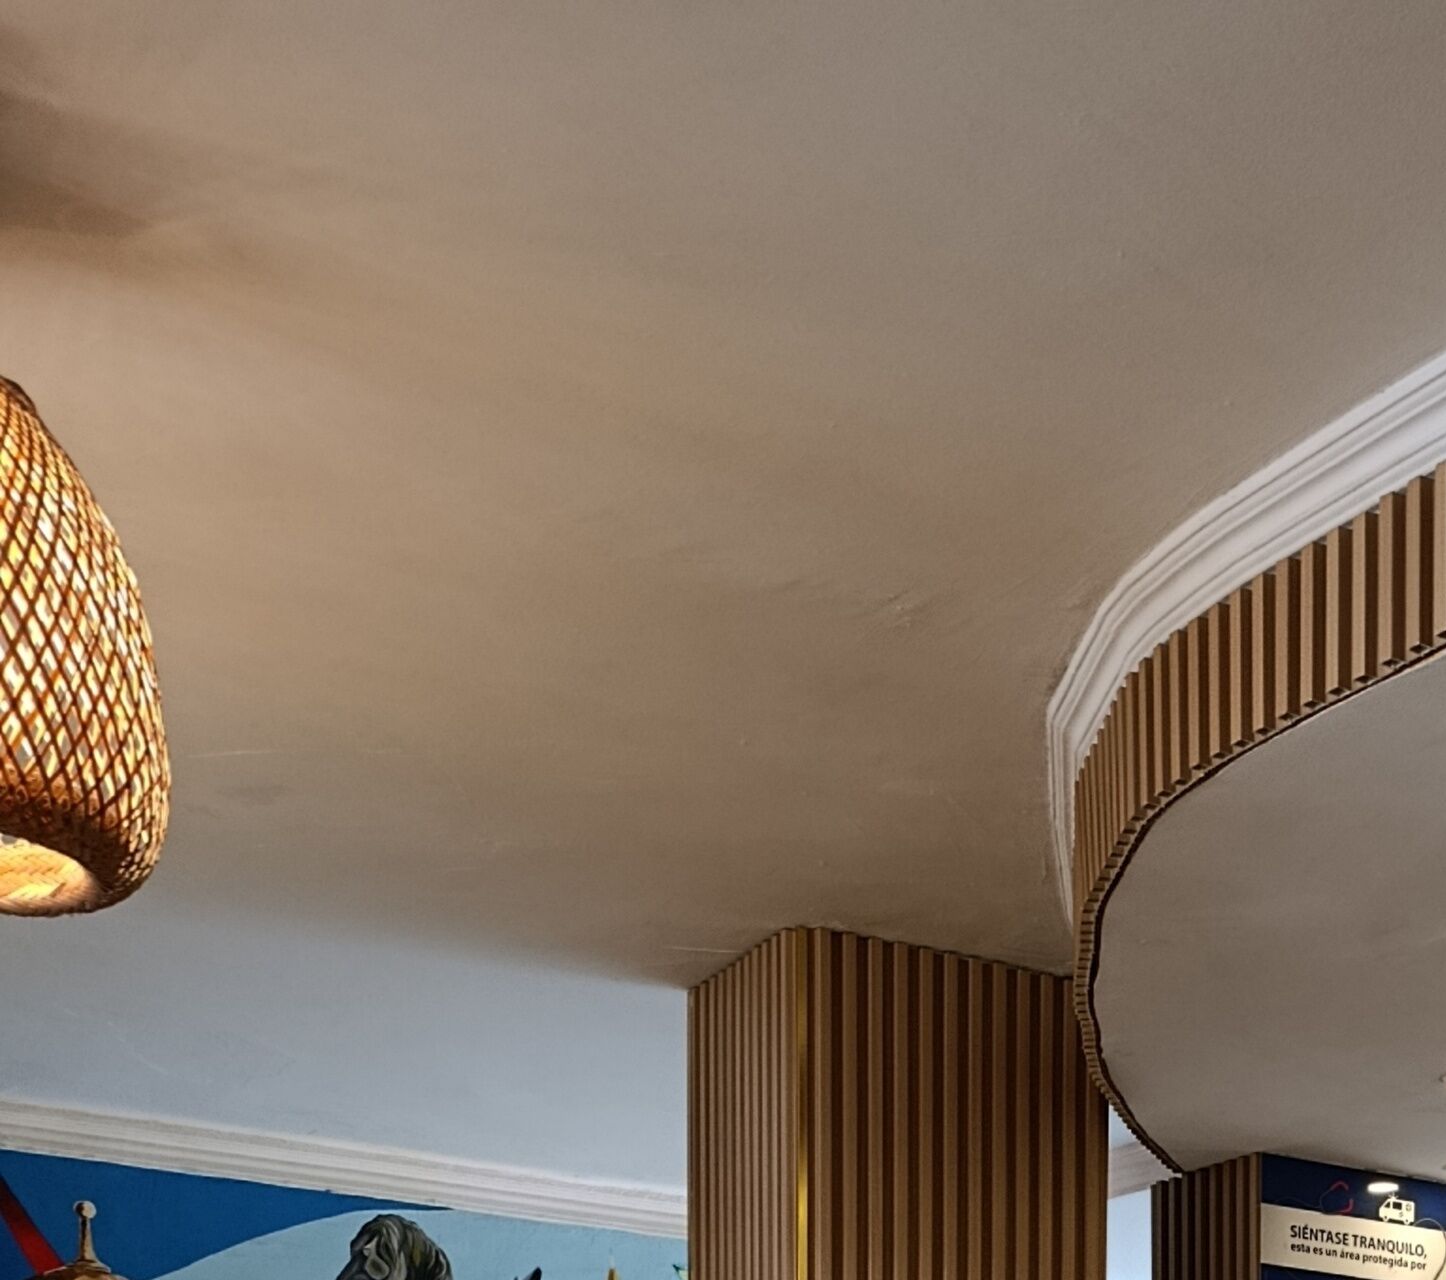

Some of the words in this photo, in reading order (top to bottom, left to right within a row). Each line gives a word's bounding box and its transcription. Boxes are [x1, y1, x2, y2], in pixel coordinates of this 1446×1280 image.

[1290, 1224, 1350, 1246] SIÉNTASE
[1352, 1234, 1427, 1259] TRANQUILO,
[1290, 1243, 1310, 1254] esta
[1313, 1246, 1323, 1256] es
[1326, 1248, 1338, 1258] un
[1340, 1249, 1360, 1261] área
[1362, 1252, 1408, 1268] protegida
[1410, 1262, 1426, 1270] por
